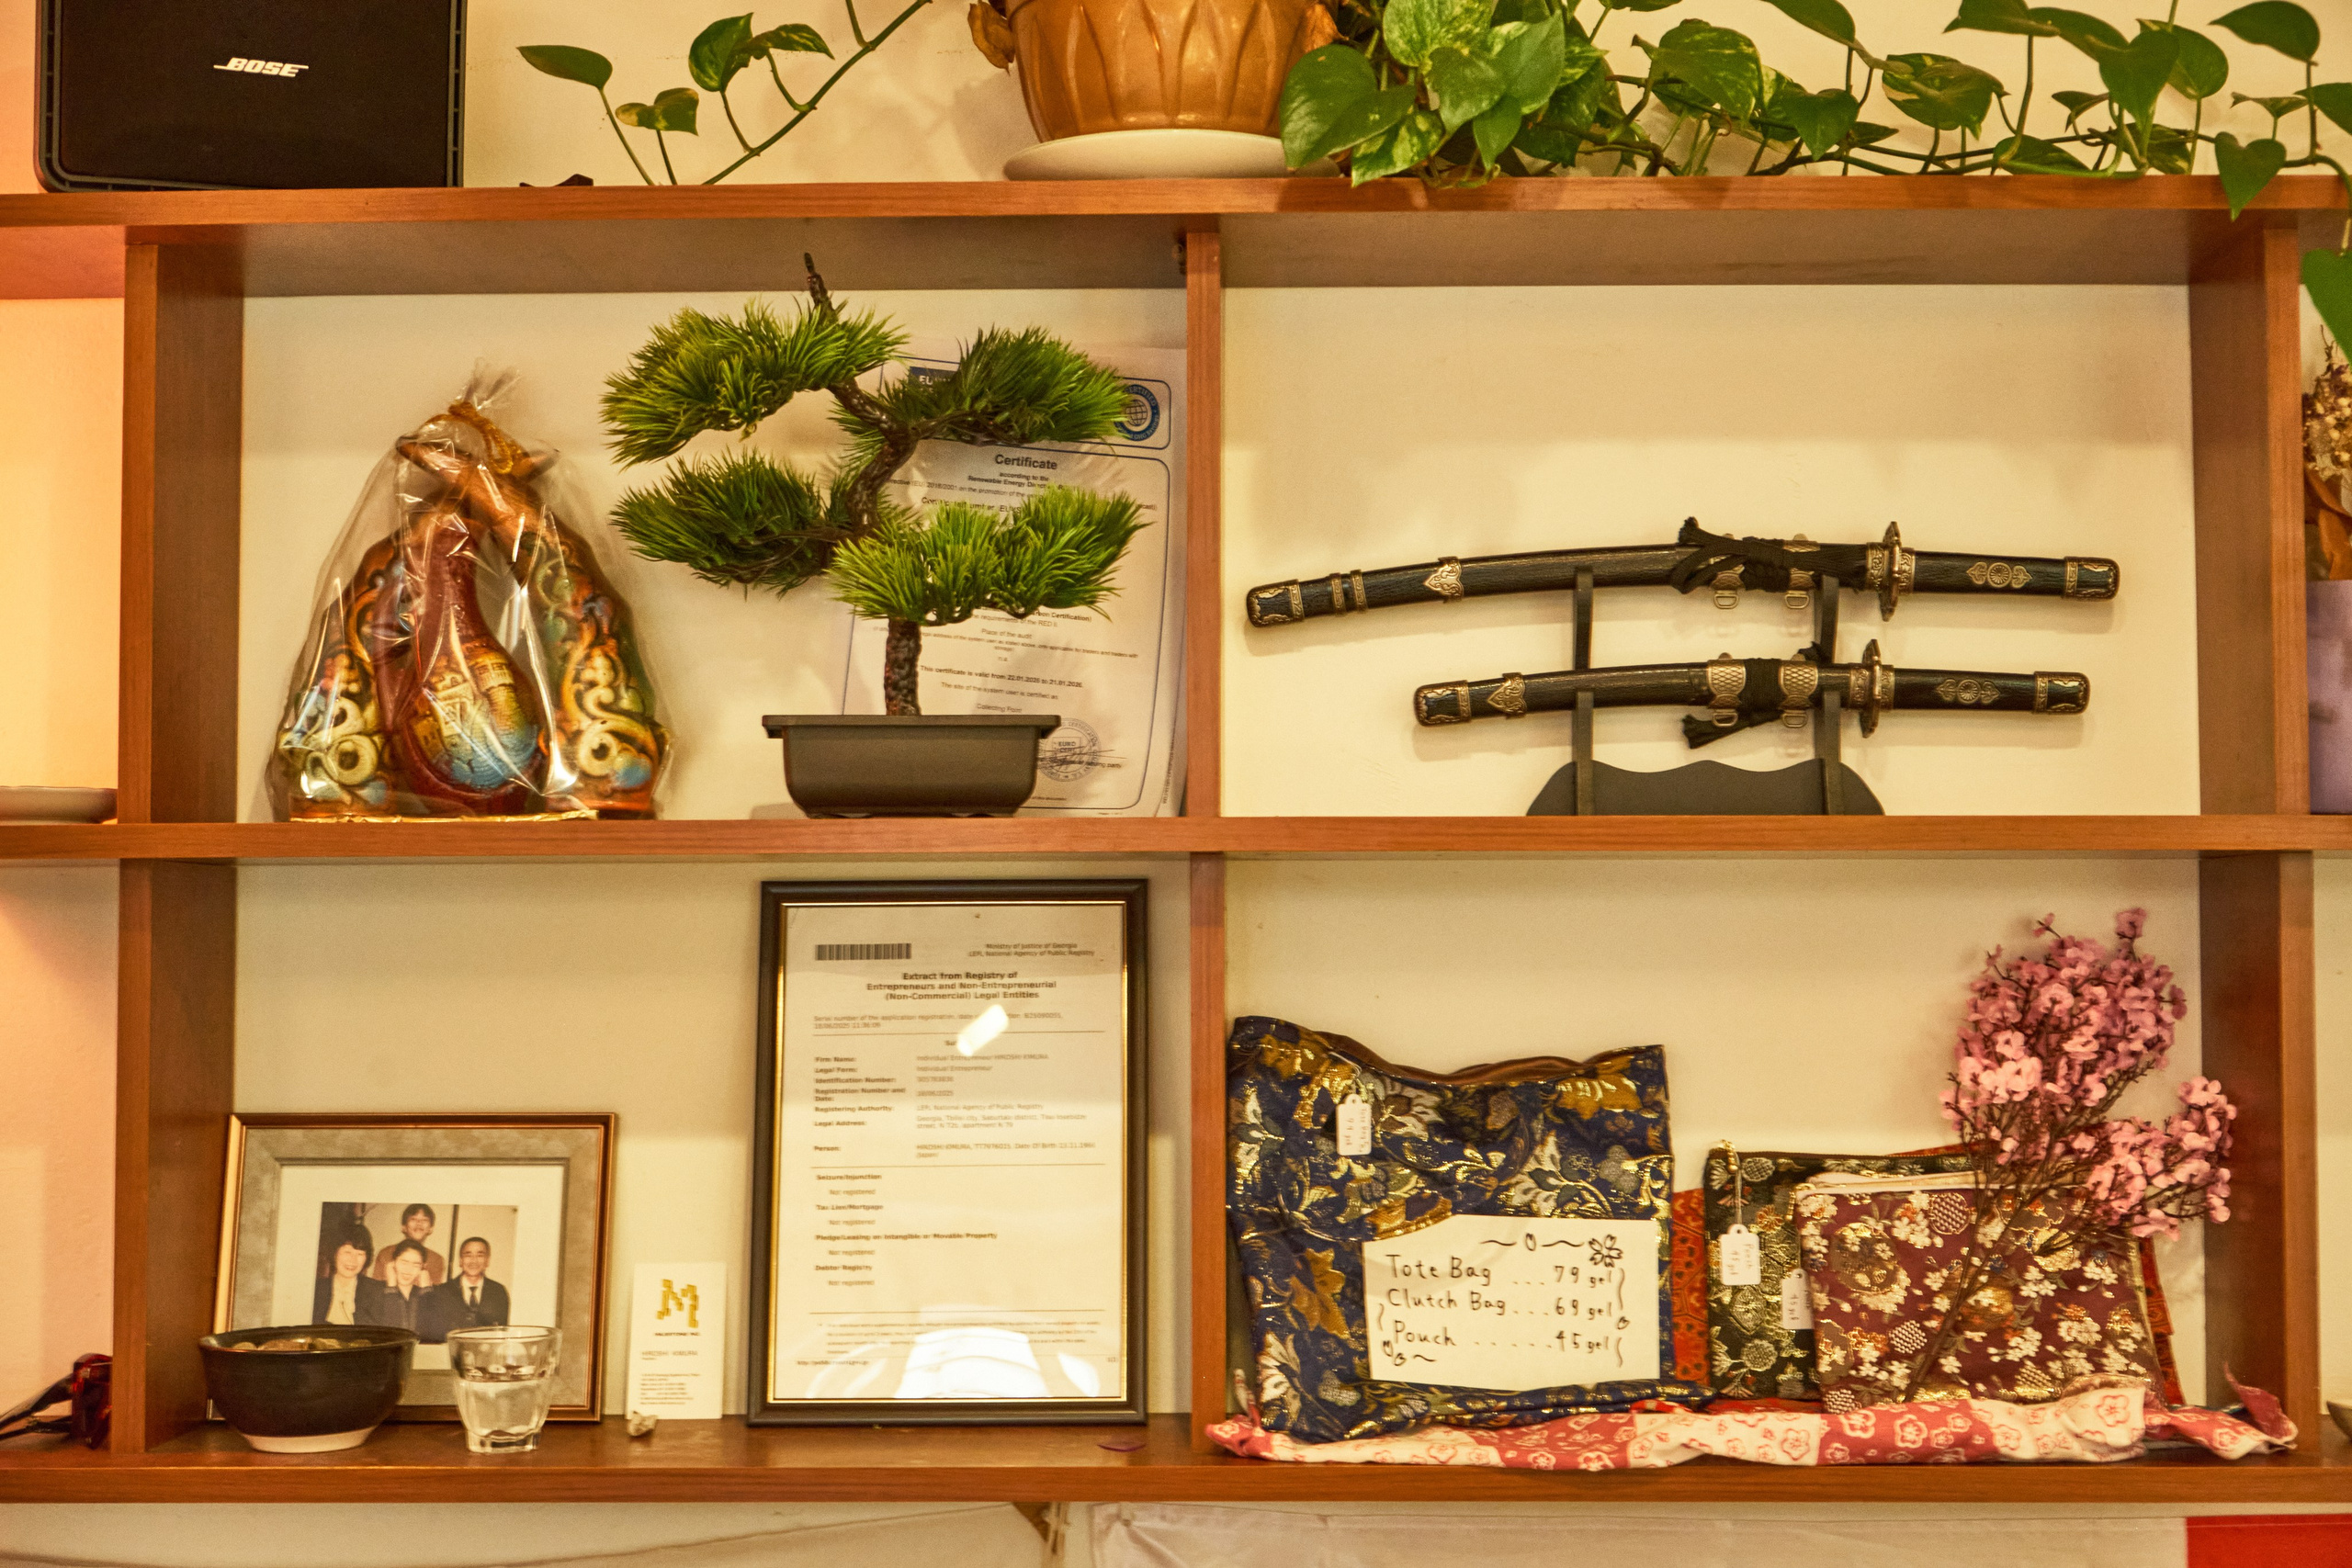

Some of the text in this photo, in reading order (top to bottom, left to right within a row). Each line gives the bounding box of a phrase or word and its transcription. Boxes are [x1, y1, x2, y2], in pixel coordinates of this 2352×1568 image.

[213, 57, 310, 78] BOSE
[994, 454, 1057, 471] Certificate
[999, 470, 1027, 481] according
[967, 475, 1026, 489] Renewable Energy
[980, 615, 1019, 624] requirements
[1051, 612, 1092, 625] Certification)
[981, 628, 998, 637] Place
[934, 667, 967, 676] certificate
[983, 687, 1004, 696] system
[976, 704, 1023, 715] Collecting Point
[985, 942, 1012, 952] Ministry
[1021, 942, 1042, 951] Justice
[1052, 942, 1078, 951] Georgia
[1012, 950, 1038, 959] Agency
[902, 971, 1018, 983] Extract from Registry of
[866, 980, 1057, 992] Entrepreneurs and Non-Entrepreneurial
[885, 990, 1040, 1002] (Non-Commercial) Legal Entities
[815, 1077, 864, 1085] Identification
[814, 1088, 860, 1096] Registration
[860, 1087, 890, 1095] Number
[814, 1105, 856, 1114] Registering
[815, 1173, 883, 1182] Seizure/Injunction
[1385, 1254, 1440, 1280] Tote
[1450, 1257, 1492, 1287] Bag
[1589, 1269, 1613, 1289] gel
[1387, 1288, 1459, 1310] Clutch
[1470, 1291, 1507, 1315] Bag
[1586, 1302, 1613, 1321] gel
[1394, 1319, 1458, 1348] Pouch
[1586, 1336, 1610, 1354] gel
